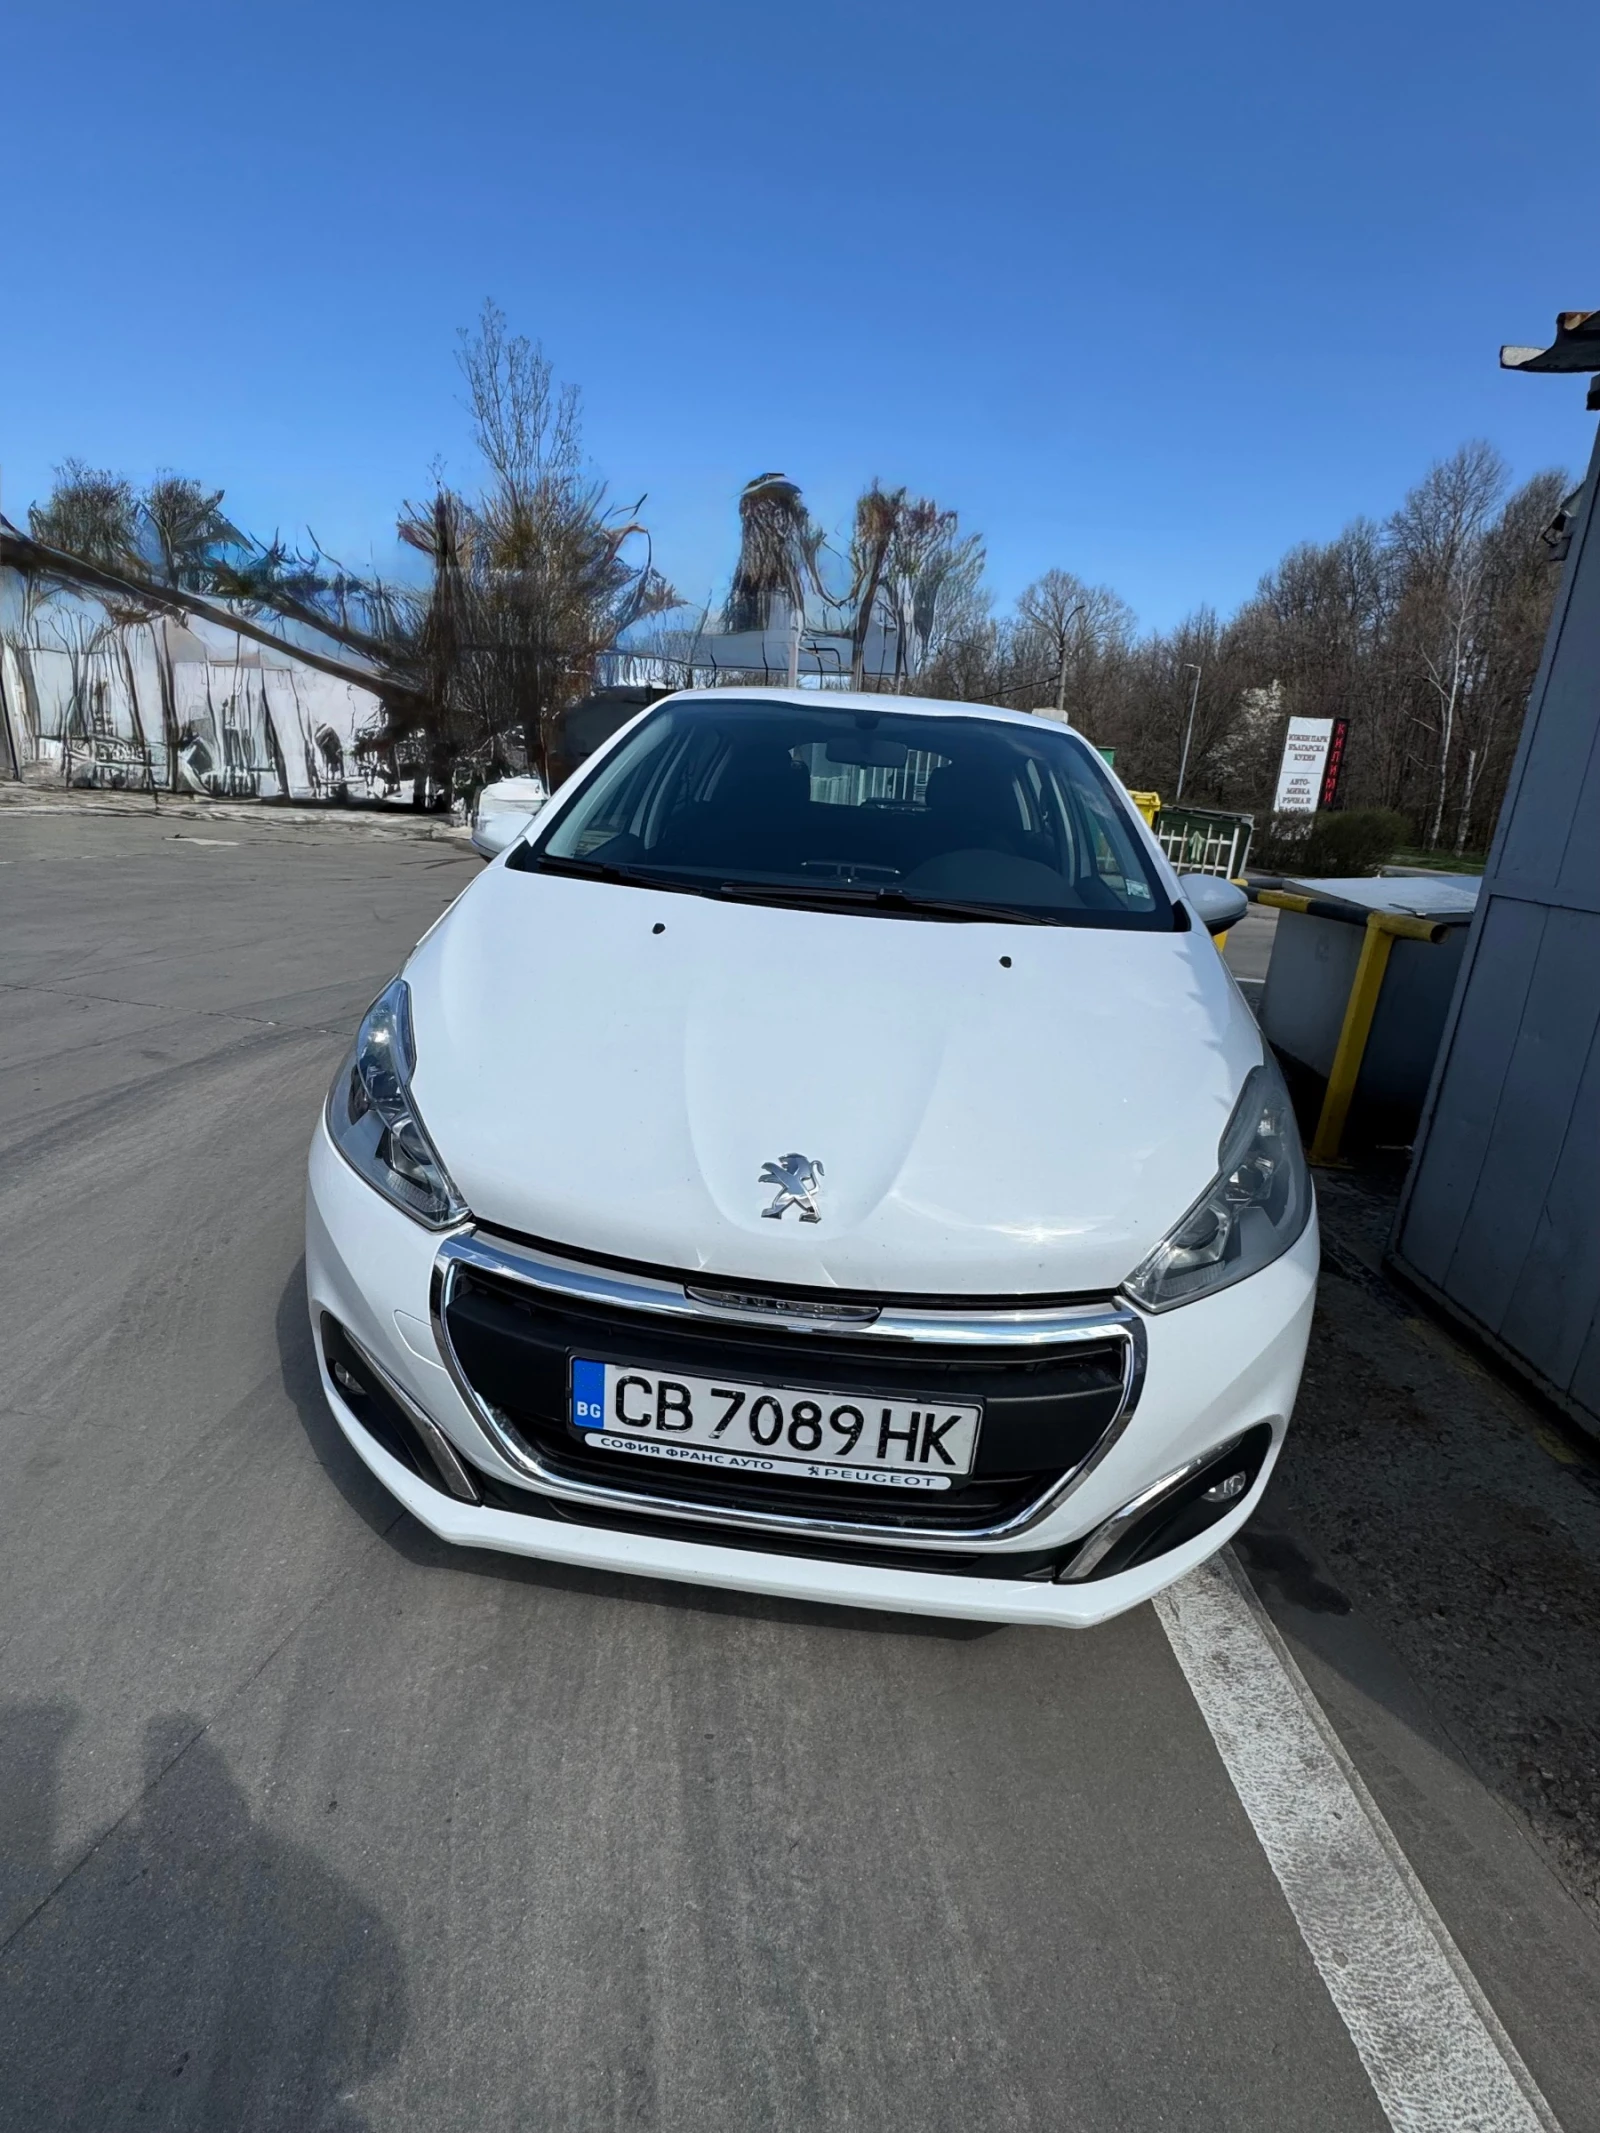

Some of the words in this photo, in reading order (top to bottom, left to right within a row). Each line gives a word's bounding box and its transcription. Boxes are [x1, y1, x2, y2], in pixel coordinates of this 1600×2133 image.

[1311, 735, 1328, 743] ПАРК
[1324, 723, 1347, 804] КИЛИМИ
[576, 1402, 601, 1418] BG
[708, 1388, 865, 1456] 7089
[600, 1437, 661, 1455] СОФИЯ
[665, 1448, 724, 1464] ФРАНС
[728, 1457, 774, 1470] АУТО
[824, 1468, 936, 1487] PEUGEOT
